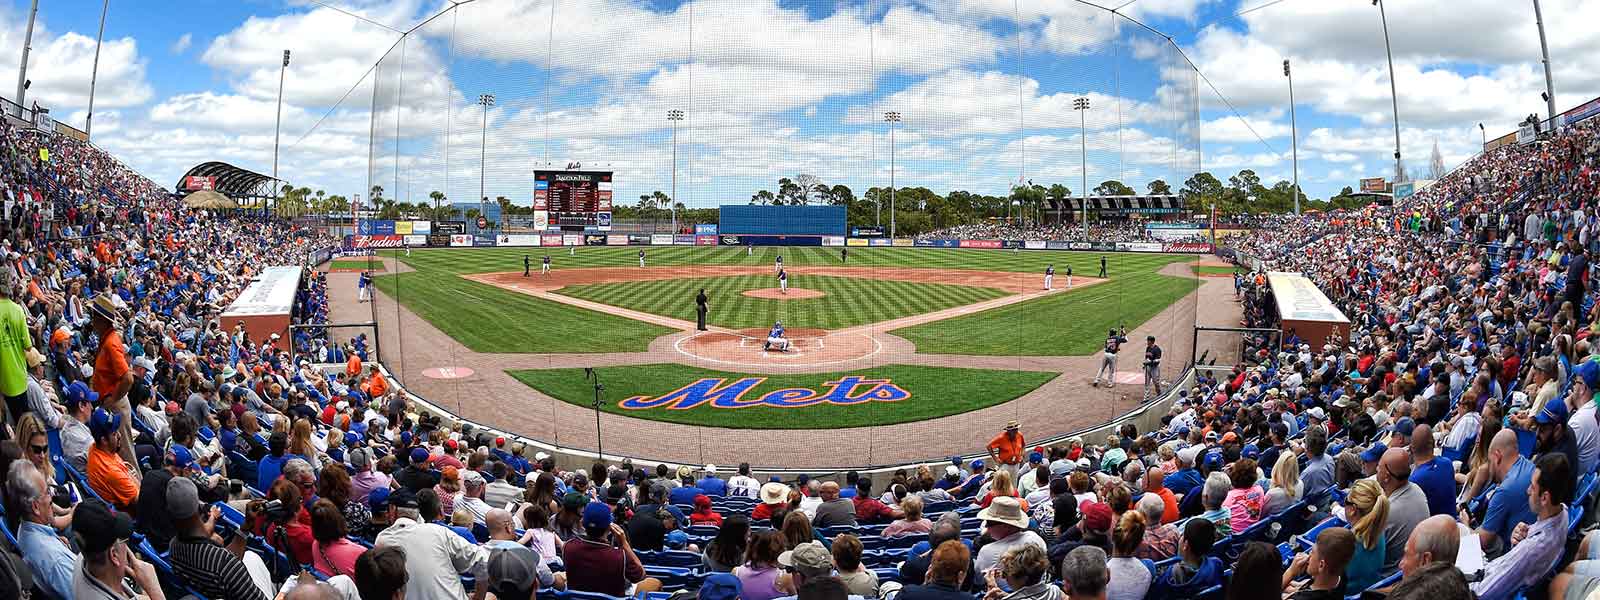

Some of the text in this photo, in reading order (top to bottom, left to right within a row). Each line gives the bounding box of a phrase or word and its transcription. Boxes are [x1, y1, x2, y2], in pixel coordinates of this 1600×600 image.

[565, 161, 581, 170] Mets
[1163, 242, 1210, 253] Budweiser
[618, 376, 911, 409] Mets
[732, 487, 749, 497] 44
